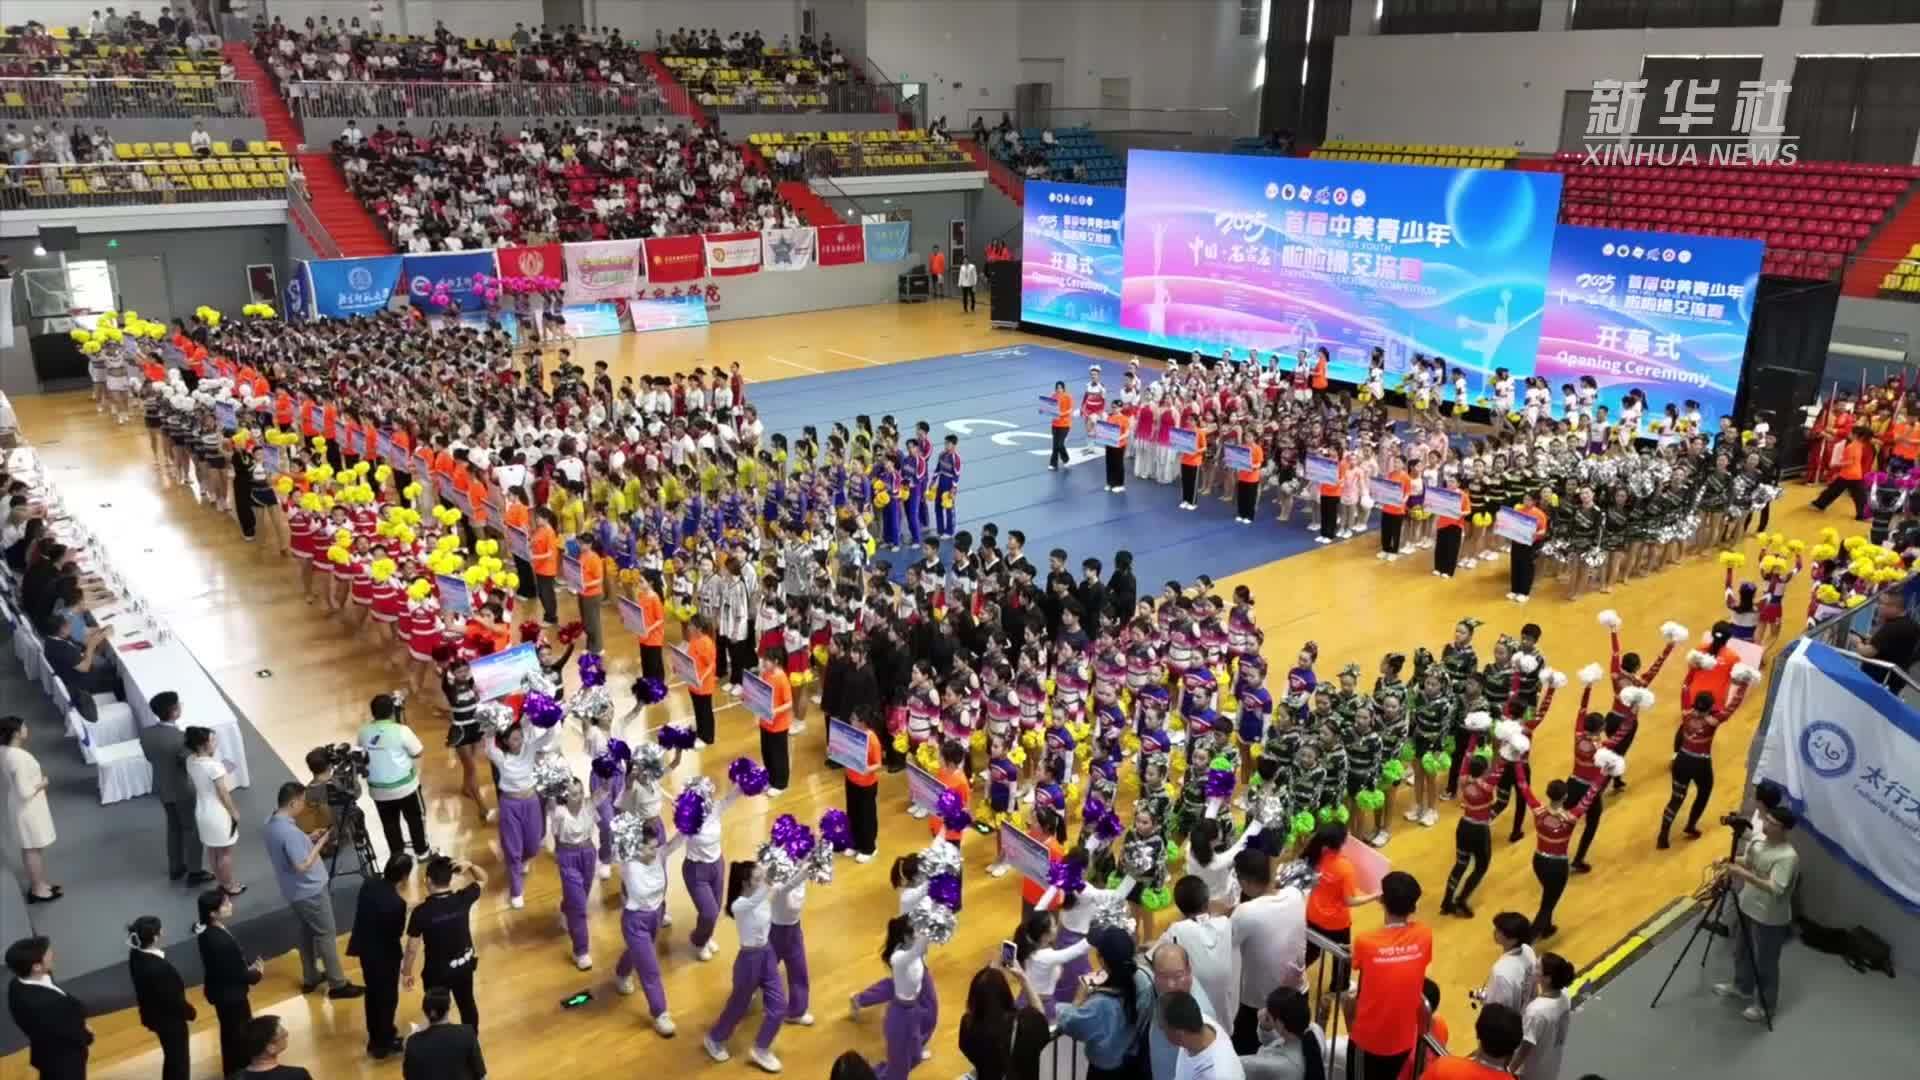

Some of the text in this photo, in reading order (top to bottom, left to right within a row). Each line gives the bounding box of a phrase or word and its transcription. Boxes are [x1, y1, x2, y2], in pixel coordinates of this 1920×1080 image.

[1285, 211, 1451, 248] 首届中美青少年
[1596, 325, 1682, 360] 开幕式
[1557, 350, 1710, 388] Opening Ceremony
